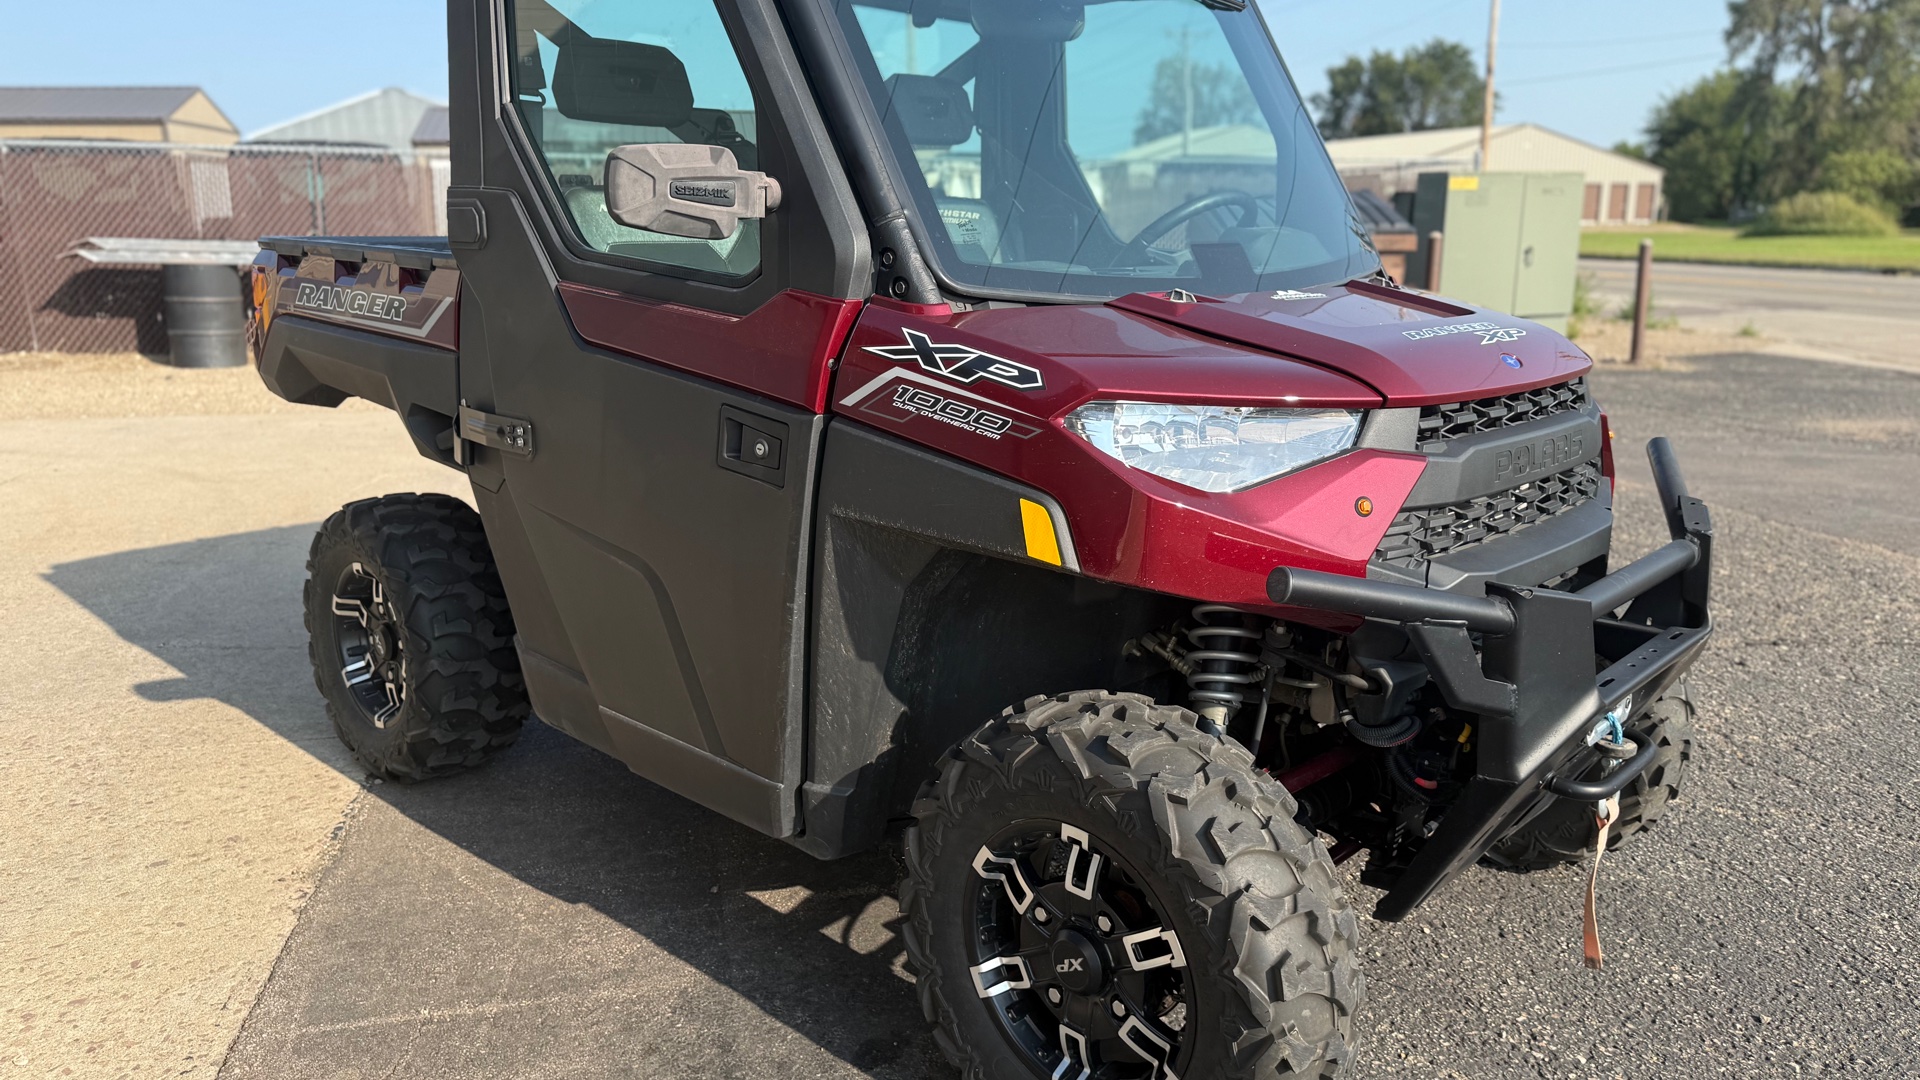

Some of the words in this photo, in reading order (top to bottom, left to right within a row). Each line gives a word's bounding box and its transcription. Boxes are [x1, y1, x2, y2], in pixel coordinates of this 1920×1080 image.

[674, 185, 730, 199] SEIZMIK
[295, 283, 407, 321] RANGER
[1402, 321, 1500, 340] RANGER
[1473, 327, 1526, 345] XP
[860, 326, 1045, 391] XP
[892, 384, 1013, 434] 1000
[892, 401, 919, 414] DUAL
[920, 410, 976, 432] OVERHEAD
[975, 429, 1001, 441] CAM
[1494, 429, 1583, 483] POLARIS
[1056, 957, 1084, 973] XP
